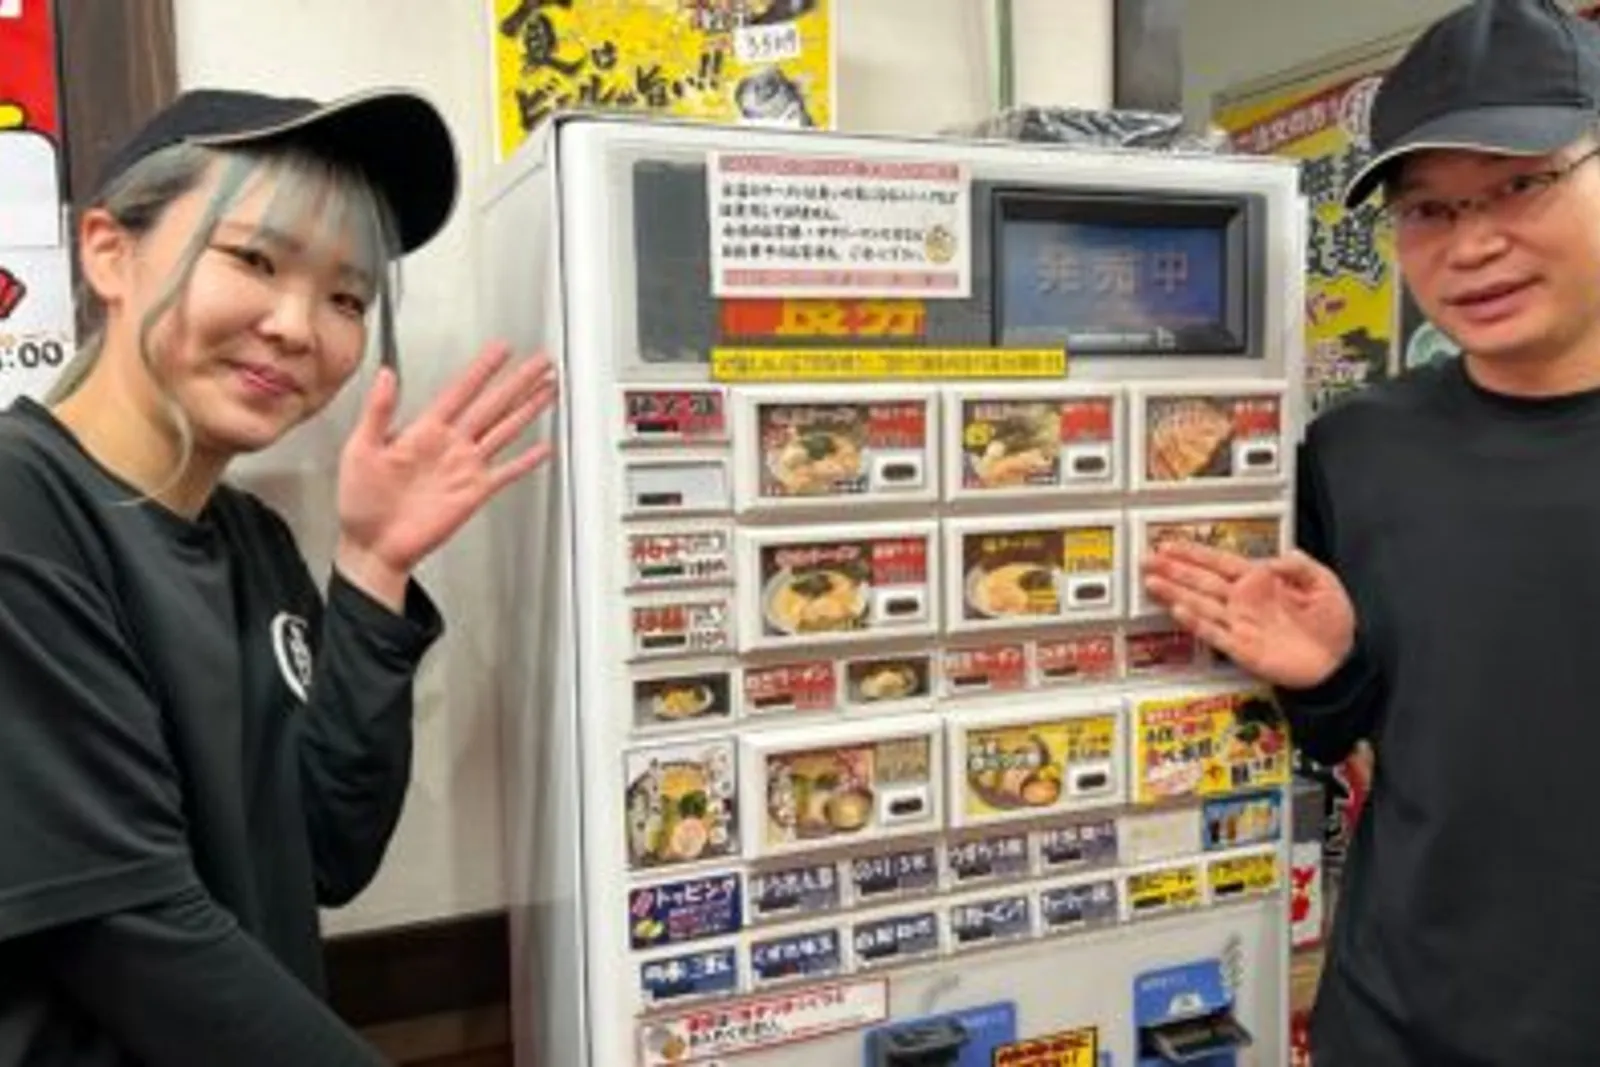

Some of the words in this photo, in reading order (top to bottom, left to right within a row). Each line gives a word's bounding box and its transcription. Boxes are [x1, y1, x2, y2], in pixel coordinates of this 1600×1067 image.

[657, 878, 735, 908] トッピング
